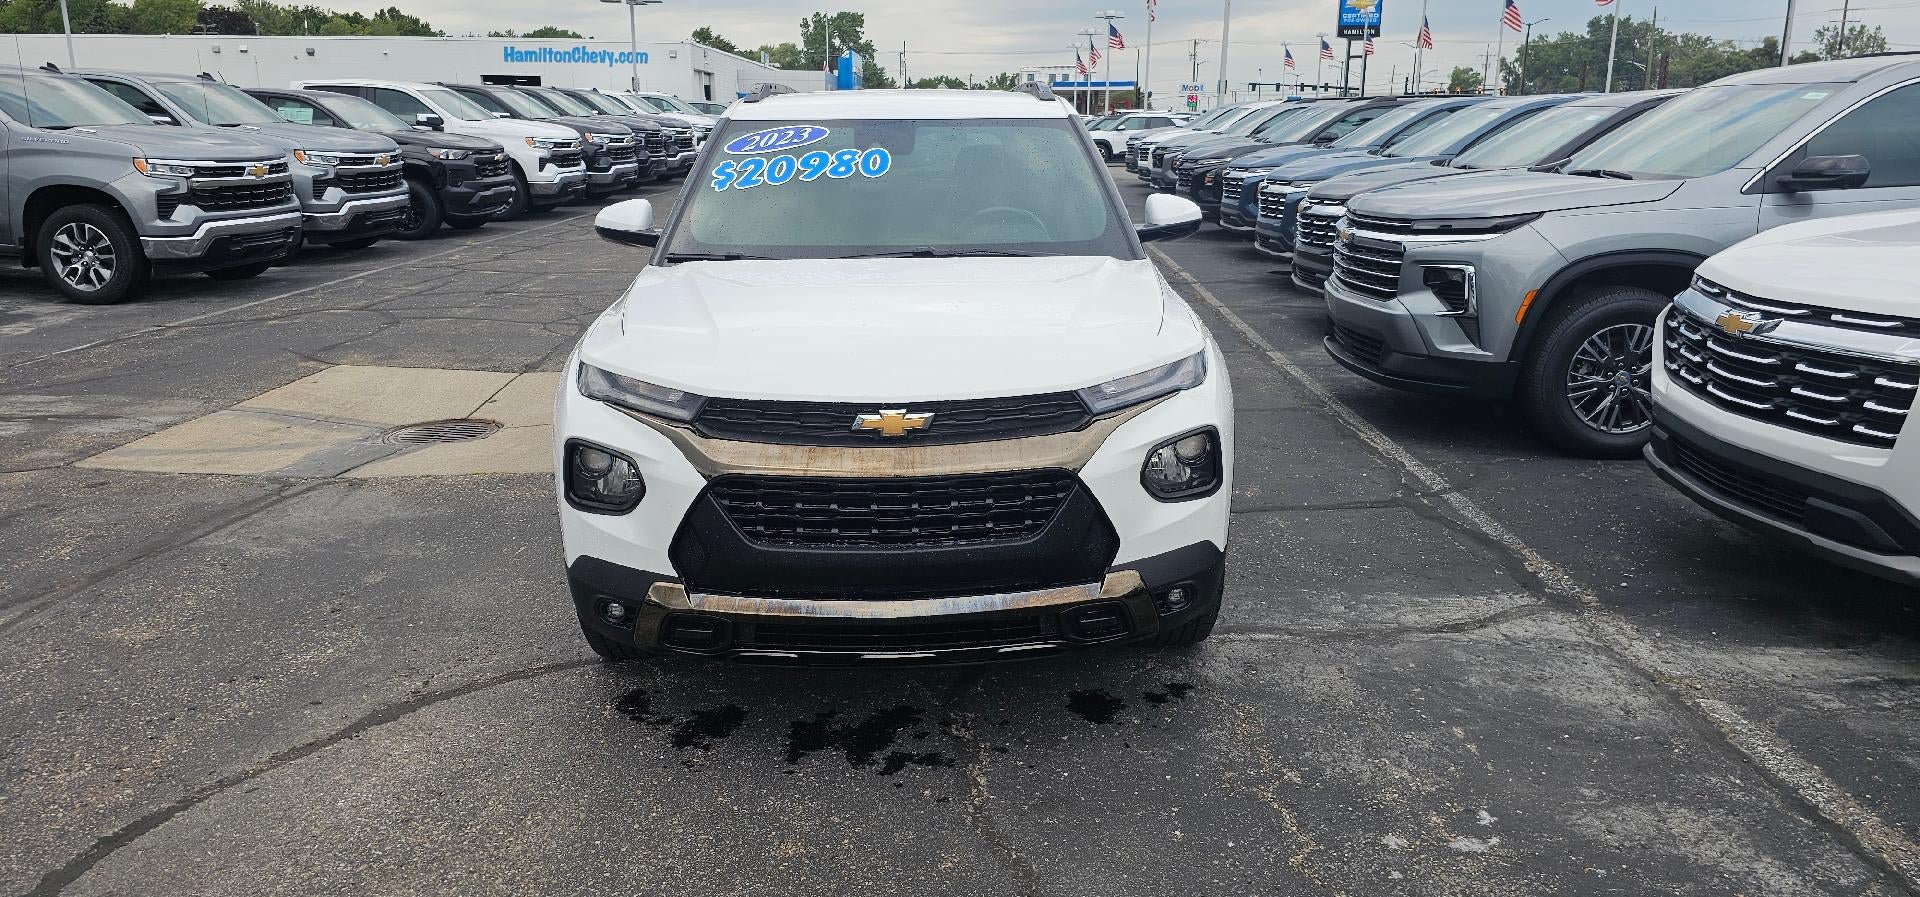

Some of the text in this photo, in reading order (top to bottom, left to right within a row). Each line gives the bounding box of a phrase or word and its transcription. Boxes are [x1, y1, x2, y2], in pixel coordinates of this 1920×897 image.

[502, 45, 648, 67] HamiltonChevy.com
[741, 127, 813, 152] 2023
[711, 147, 891, 191] $20980
